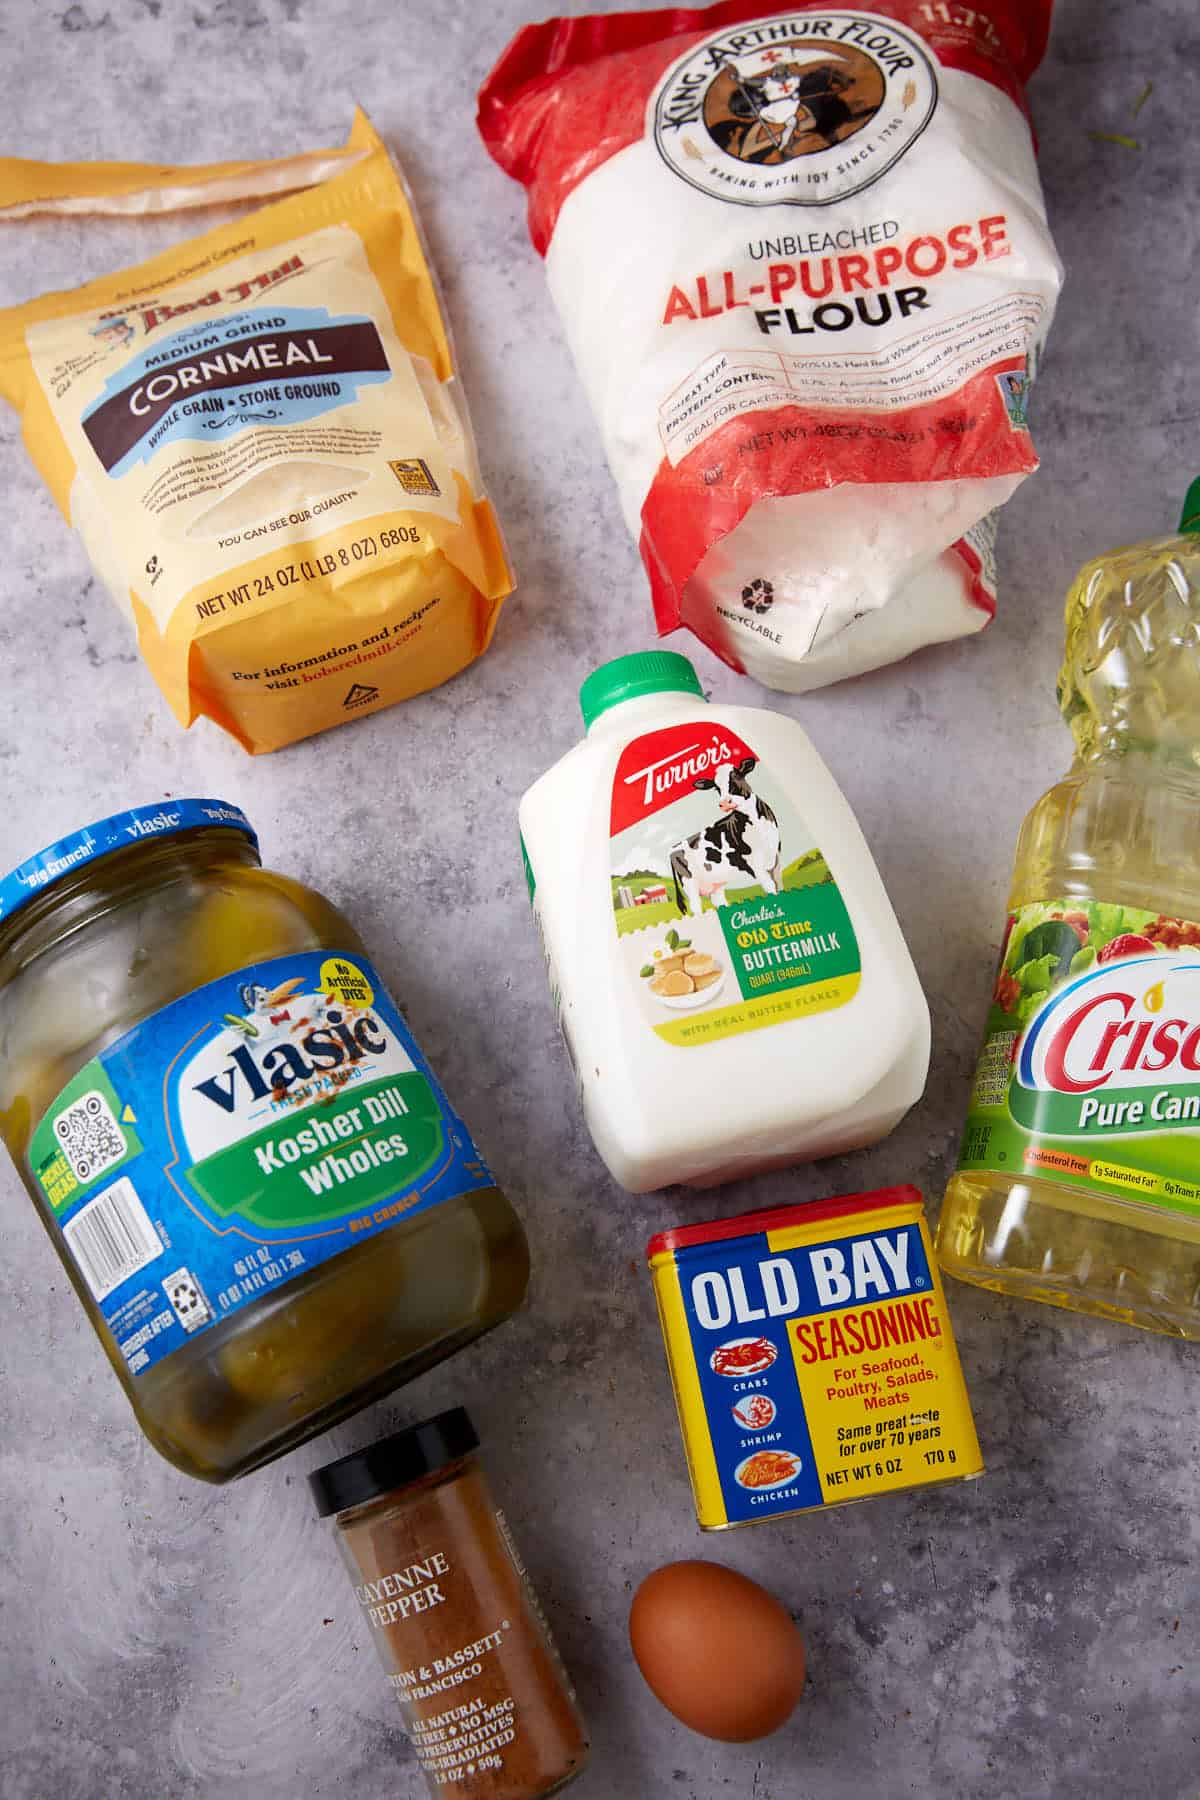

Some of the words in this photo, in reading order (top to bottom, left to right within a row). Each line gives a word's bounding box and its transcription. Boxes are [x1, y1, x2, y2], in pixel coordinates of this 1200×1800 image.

[662, 70, 707, 133] KING
[704, 20, 834, 71] ARTHUR
[837, 21, 915, 77] FLOUR
[709, 167, 757, 189] BAKING
[764, 174, 799, 189] WITH
[807, 171, 830, 184] JOY
[836, 143, 876, 173] SINCE
[213, 238, 256, 264] Company
[748, 219, 900, 260] UNBLEACHED
[662, 215, 1011, 326] ALL-PURPOSE
[139, 291, 223, 335] Red
[755, 285, 931, 335] FLOUR
[145, 334, 220, 368] MEDIUM
[226, 317, 287, 339] GRIND
[129, 337, 334, 416] CORNMEAL
[703, 357, 729, 383] TYPE
[684, 419, 712, 446] IDEAL
[713, 403, 737, 421] FOR
[957, 337, 1020, 376] PANCAKES
[147, 411, 180, 448] WHOLE
[182, 398, 225, 416] GRAIN
[239, 385, 283, 407] STONE
[284, 382, 342, 400] GROUND
[666, 393, 712, 432] PROTEIN
[218, 538, 241, 550] YOU
[243, 526, 267, 542] CAN
[268, 519, 287, 532] SEE
[288, 510, 311, 526] OUR
[196, 598, 226, 620] NET
[227, 584, 251, 606] WT
[253, 576, 275, 598] 24
[277, 566, 299, 588] OZ
[301, 560, 316, 585] (1
[316, 554, 337, 577] LB
[339, 549, 351, 567] 8
[352, 539, 378, 563] OZ)
[380, 525, 421, 549] 680g
[715, 606, 784, 644] RECYCLABLE
[232, 670, 261, 683] For
[263, 642, 359, 679] information
[360, 626, 391, 648] and
[264, 675, 300, 691] visit
[303, 625, 424, 685] bobsredmill.com
[624, 736, 731, 804] Turner's
[125, 811, 181, 839] vlasic
[47, 838, 97, 875] Crunch!"
[730, 904, 785, 930] Charlie's
[736, 928, 768, 949] Old
[770, 919, 813, 946] Time
[335, 962, 350, 975] No
[742, 932, 841, 971] BUTTERMILK
[326, 976, 368, 989] Artificial
[341, 988, 367, 1001] DYES
[749, 974, 775, 989] QUART
[680, 1022, 710, 1038] WITH
[713, 1015, 745, 1030] REAL
[749, 1001, 792, 1021] BUTTER
[796, 989, 841, 1007] FLAKES
[192, 1010, 387, 1115] vlasic
[1079, 1097, 1144, 1128] Pure
[254, 1113, 364, 1175] Kosher
[370, 1090, 411, 1129] Dill
[299, 1133, 410, 1196] Wholes
[1094, 1164, 1103, 1177] 1g
[1104, 1167, 1141, 1185] Saturated
[1164, 1181, 1175, 1194] 0g
[1174, 1184, 1195, 1199] Trans
[349, 1219, 373, 1235] BIG
[691, 1258, 800, 1330] OLD
[809, 1231, 911, 1306] BAY
[796, 1297, 942, 1365] SEASONING
[733, 1378, 769, 1392] CRABS
[826, 1380, 882, 1402] Poultry,
[886, 1368, 939, 1389] Salads,
[834, 1367, 857, 1383] For
[861, 1354, 924, 1377] Seafood,
[863, 1393, 910, 1411] Meats
[740, 1432, 782, 1448] SHRIMP
[837, 1424, 873, 1442] Same
[875, 1415, 907, 1436] great
[910, 1409, 940, 1425] taste
[839, 1442, 857, 1457] for
[859, 1438, 885, 1454] over
[889, 1431, 906, 1448] 70
[908, 1425, 941, 1447] years
[826, 1469, 849, 1487] NET
[852, 1464, 873, 1482] WT
[875, 1462, 884, 1476] 6
[886, 1458, 903, 1474] OZ
[923, 1449, 945, 1466] 170
[948, 1449, 957, 1464] g
[750, 1487, 799, 1506] CHICKEN
[367, 1584, 446, 1628] PEPPER
[418, 1665, 432, 1681] &
[432, 1630, 504, 1675] BASSETT
[411, 1662, 482, 1700] FRANCISCO
[422, 1728, 448, 1745] FREE
[459, 1715, 481, 1733] NO
[482, 1697, 515, 1723] MSG
[428, 1698, 487, 1729] NATURAL
[423, 1712, 515, 1758] PRESERVATIVES
[448, 1766, 465, 1782] OZ
[477, 1754, 503, 1771] 50g
